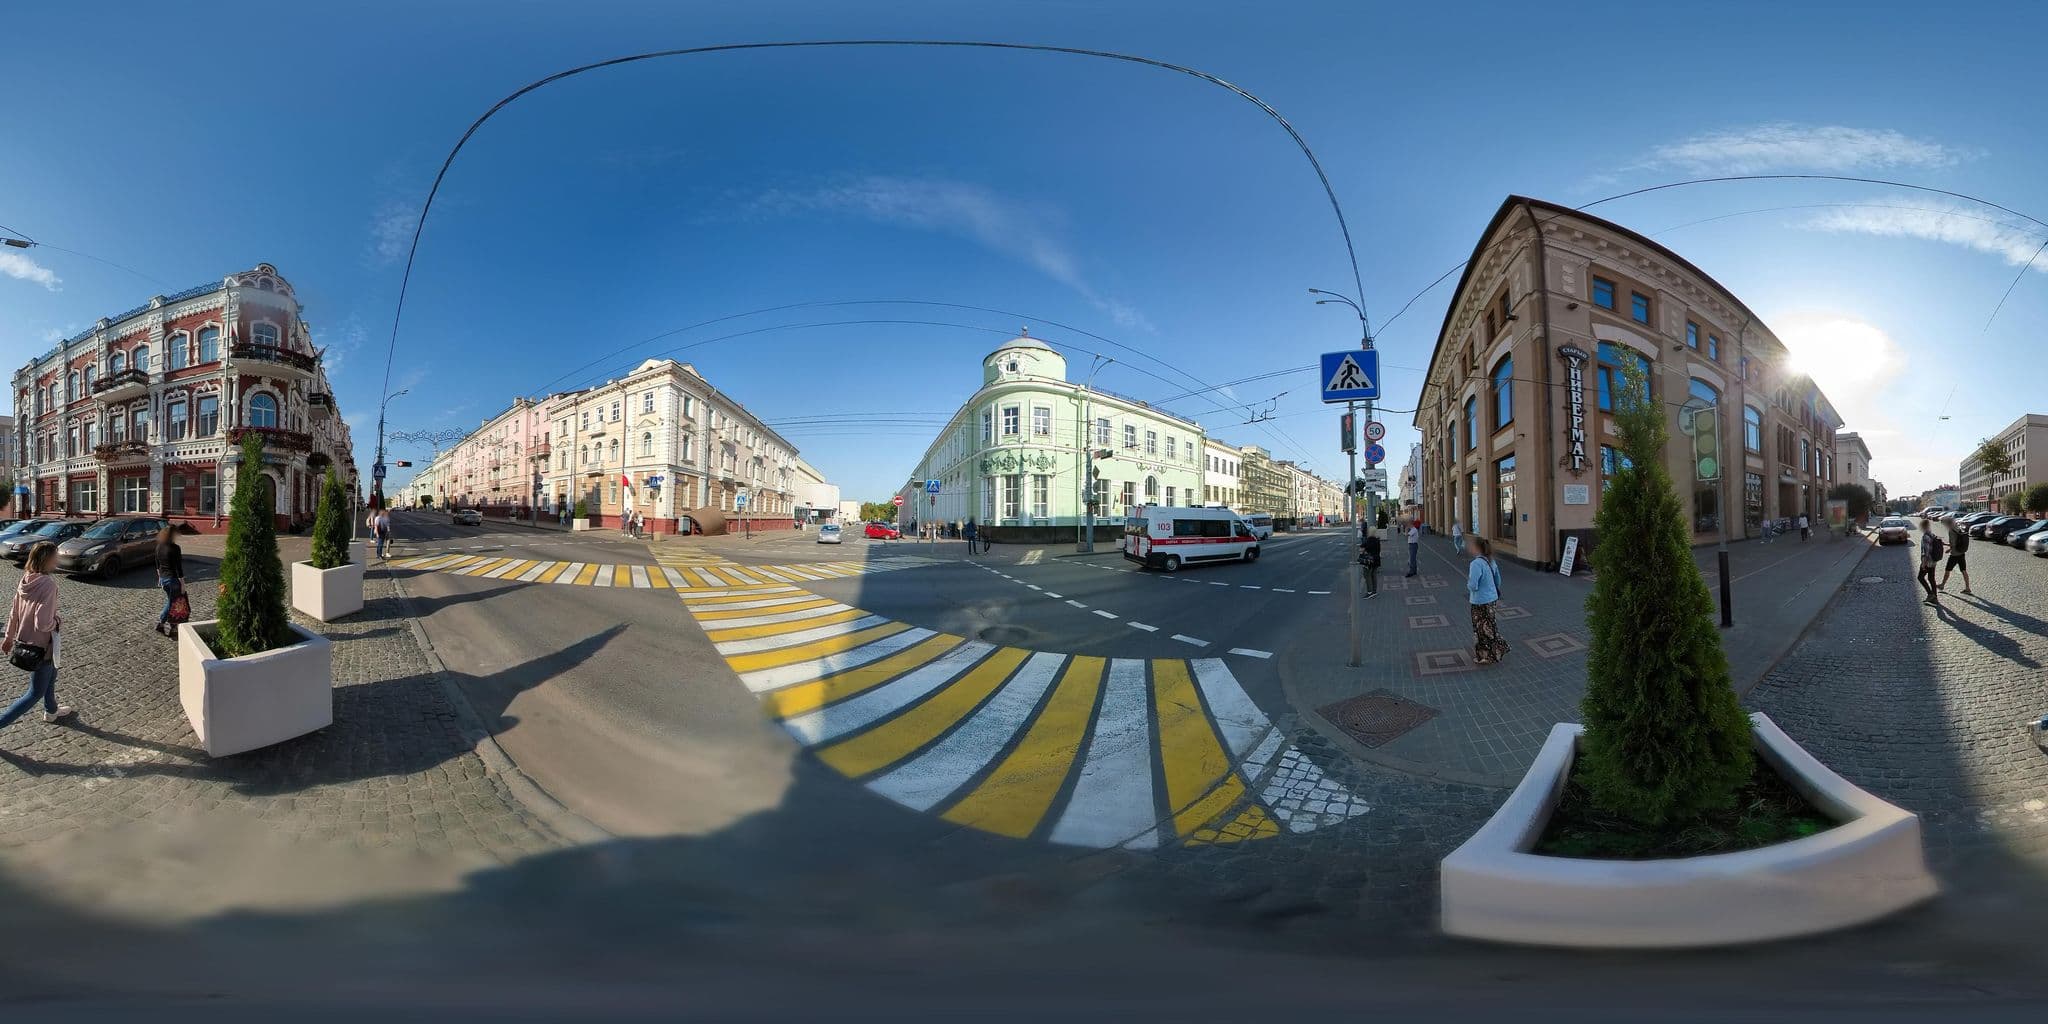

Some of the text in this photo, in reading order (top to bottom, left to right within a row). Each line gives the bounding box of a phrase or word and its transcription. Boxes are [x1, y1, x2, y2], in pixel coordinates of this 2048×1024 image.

[1569, 356, 1584, 469] УНИВЕРМАГ
[1369, 427, 1381, 436] 50
[1157, 523, 1171, 531] 103
